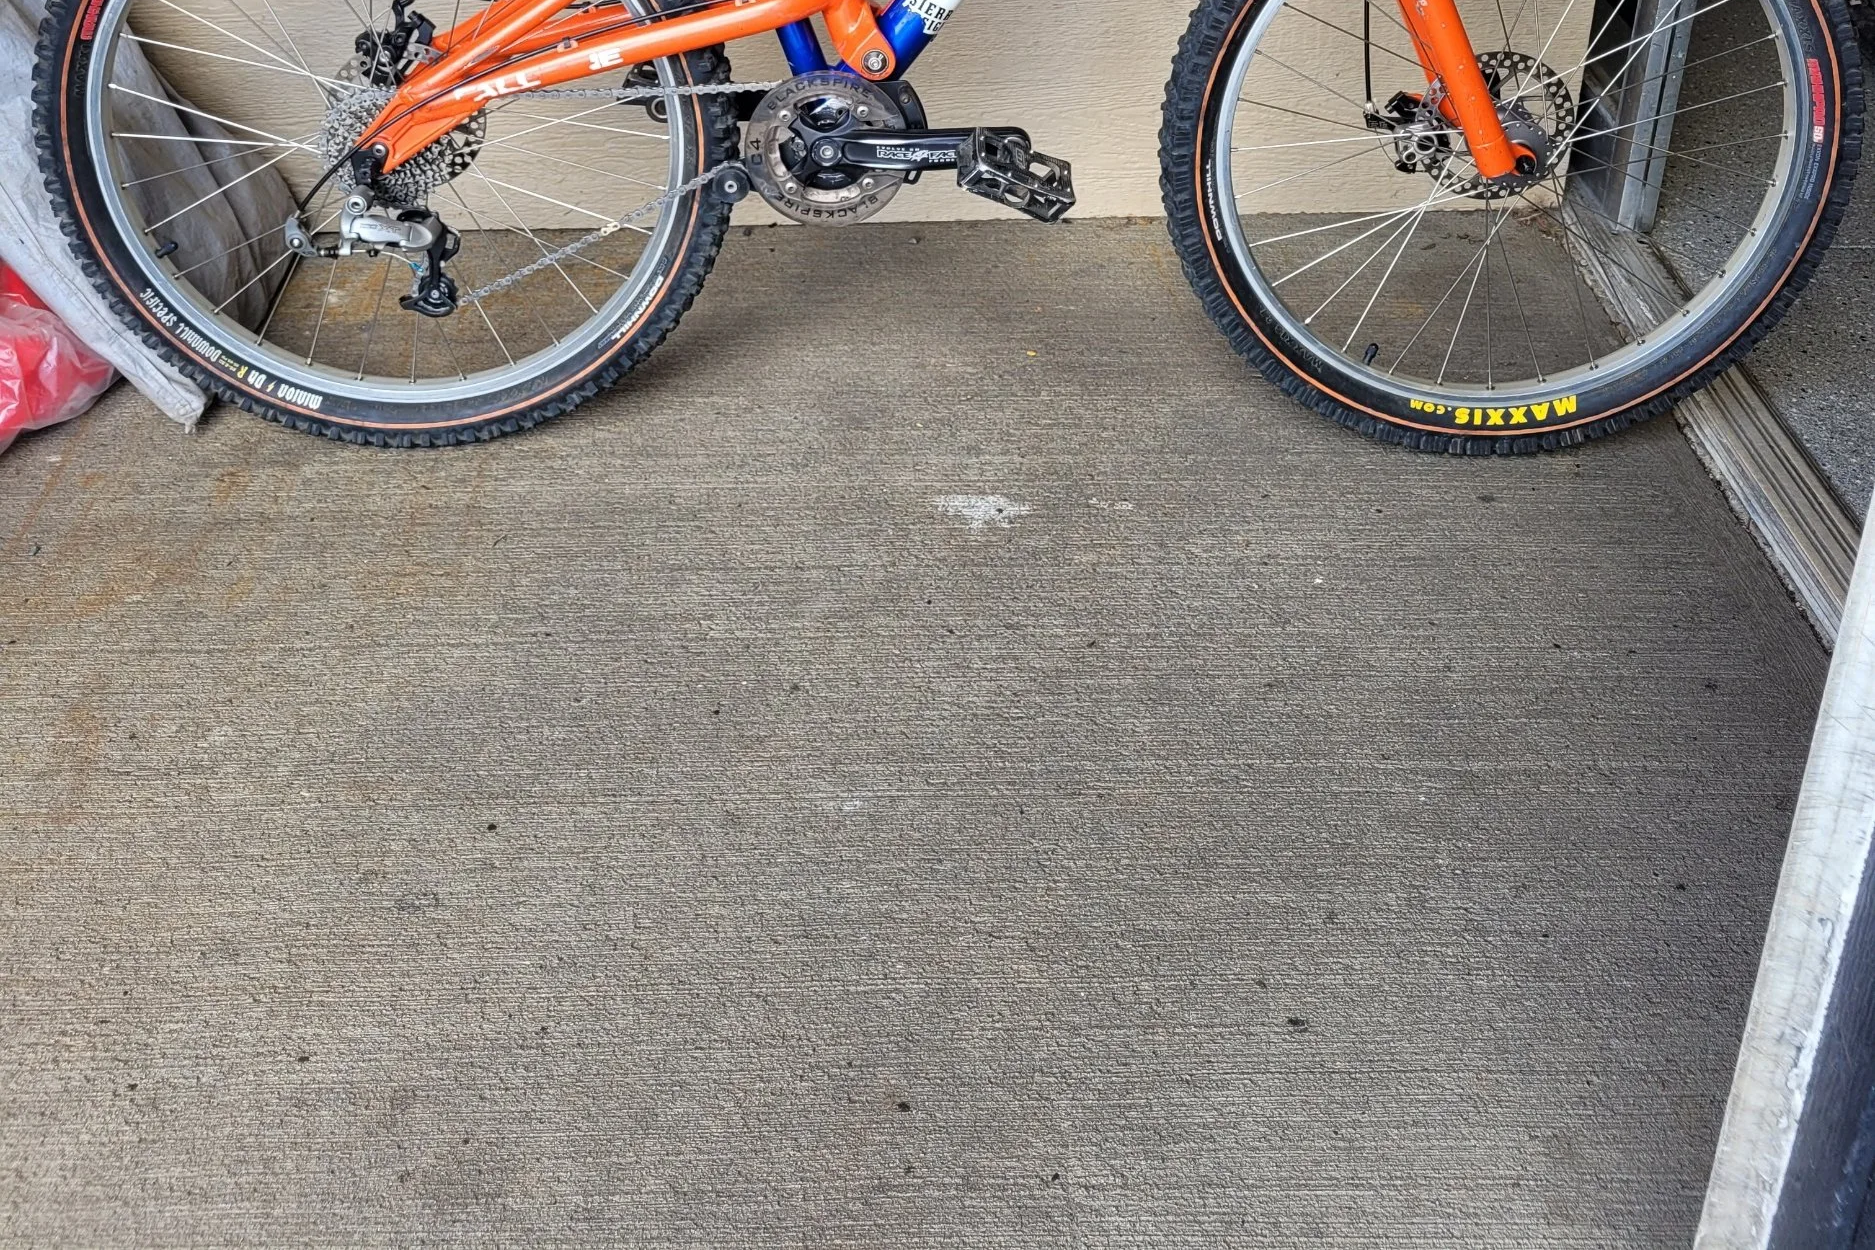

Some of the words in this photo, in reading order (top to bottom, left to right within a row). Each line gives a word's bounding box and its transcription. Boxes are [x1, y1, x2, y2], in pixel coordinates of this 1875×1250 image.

[767, 78, 872, 112] BLACKSPIRE
[751, 138, 764, 164] C4
[876, 149, 912, 160] RACE
[775, 194, 879, 219] BLACKSPIRE
[1205, 158, 1223, 242] DOWNHILL
[611, 275, 665, 340] DOWNHILL
